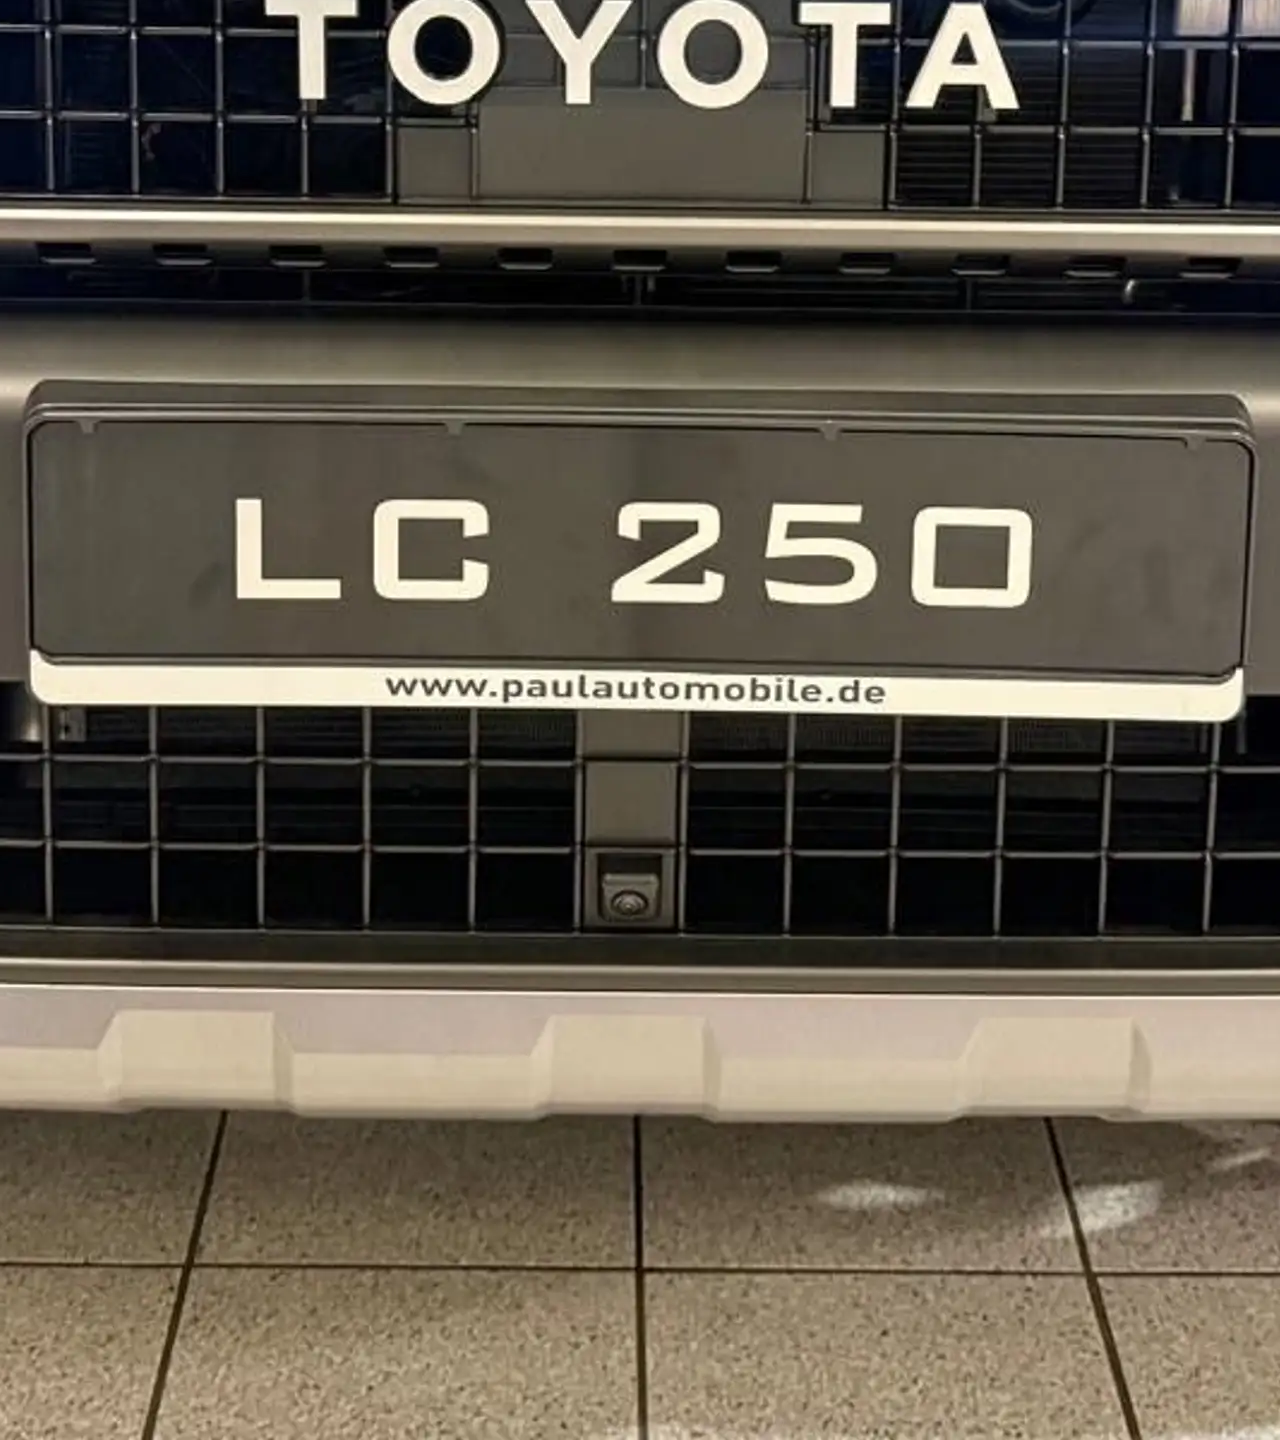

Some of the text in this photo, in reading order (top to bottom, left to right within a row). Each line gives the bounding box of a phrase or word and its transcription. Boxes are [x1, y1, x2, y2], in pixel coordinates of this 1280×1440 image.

[236, 498, 1033, 608] LC 250
[385, 674, 886, 705] www.paulautomobile.de
